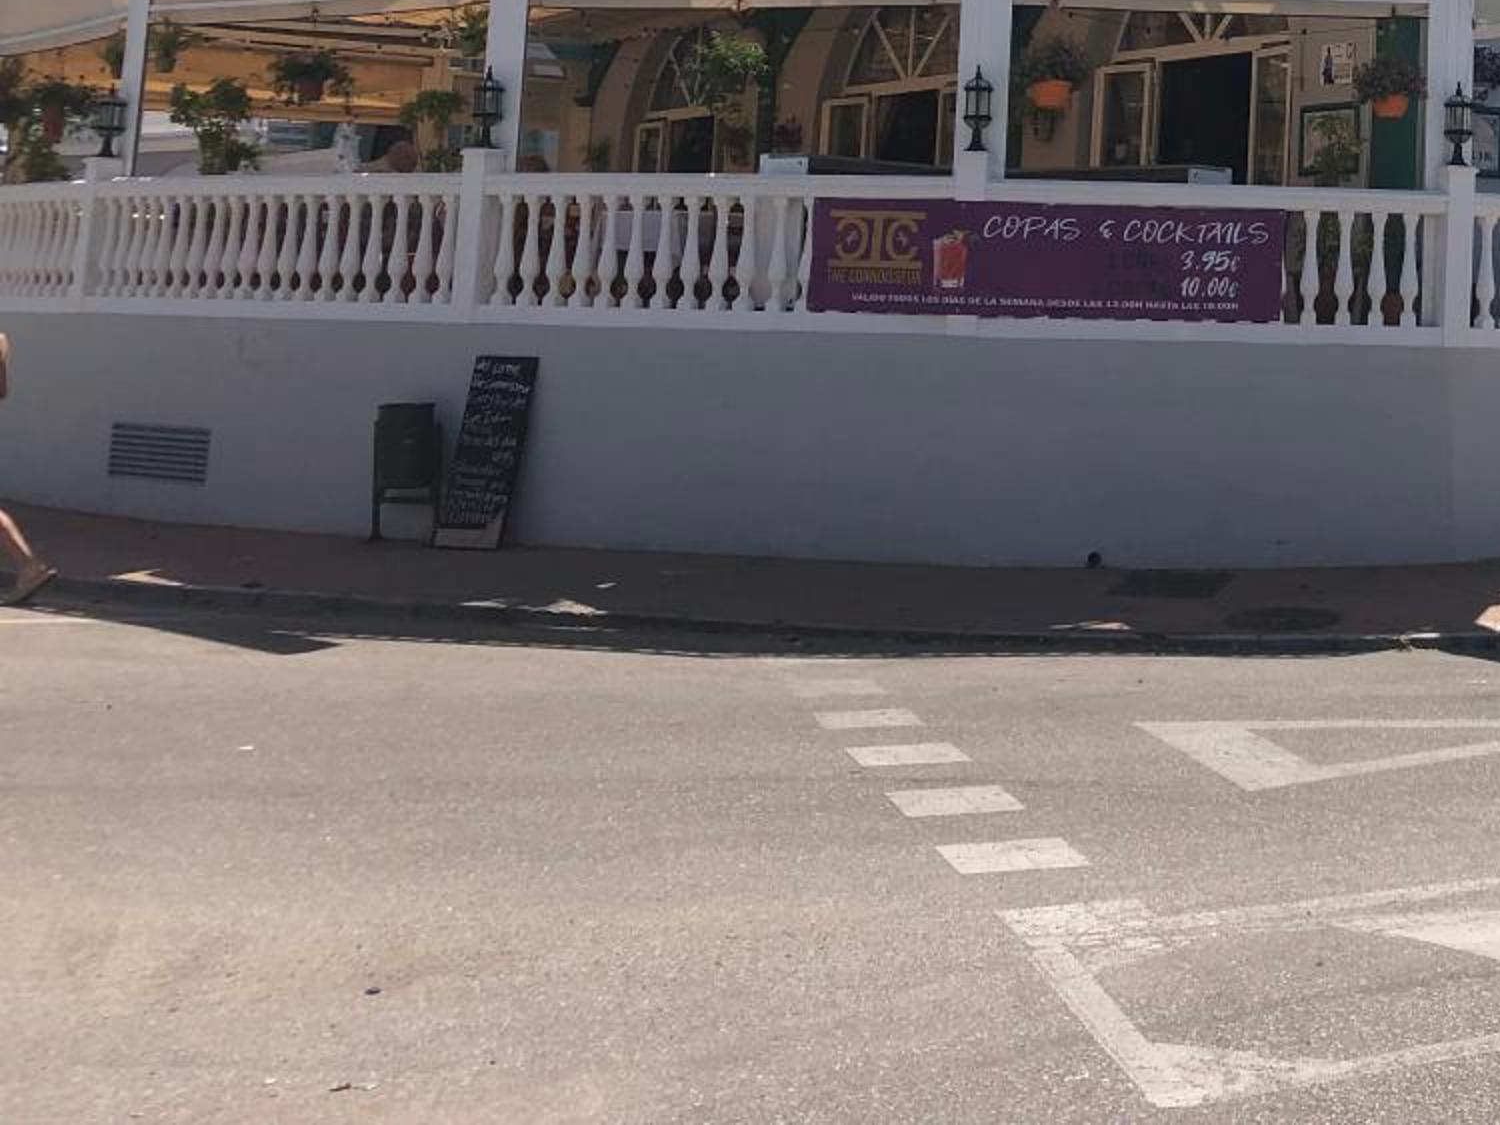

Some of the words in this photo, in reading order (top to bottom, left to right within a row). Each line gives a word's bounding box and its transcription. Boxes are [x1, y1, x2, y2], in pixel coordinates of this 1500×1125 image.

[983, 215, 1081, 241] COPAS
[1123, 219, 1269, 245] COCKTAILS
[1180, 250, 1241, 273] 3.95€
[1179, 276, 1240, 299] 10.00€
[968, 296, 982, 306] DE
[984, 297, 998, 306] LA
